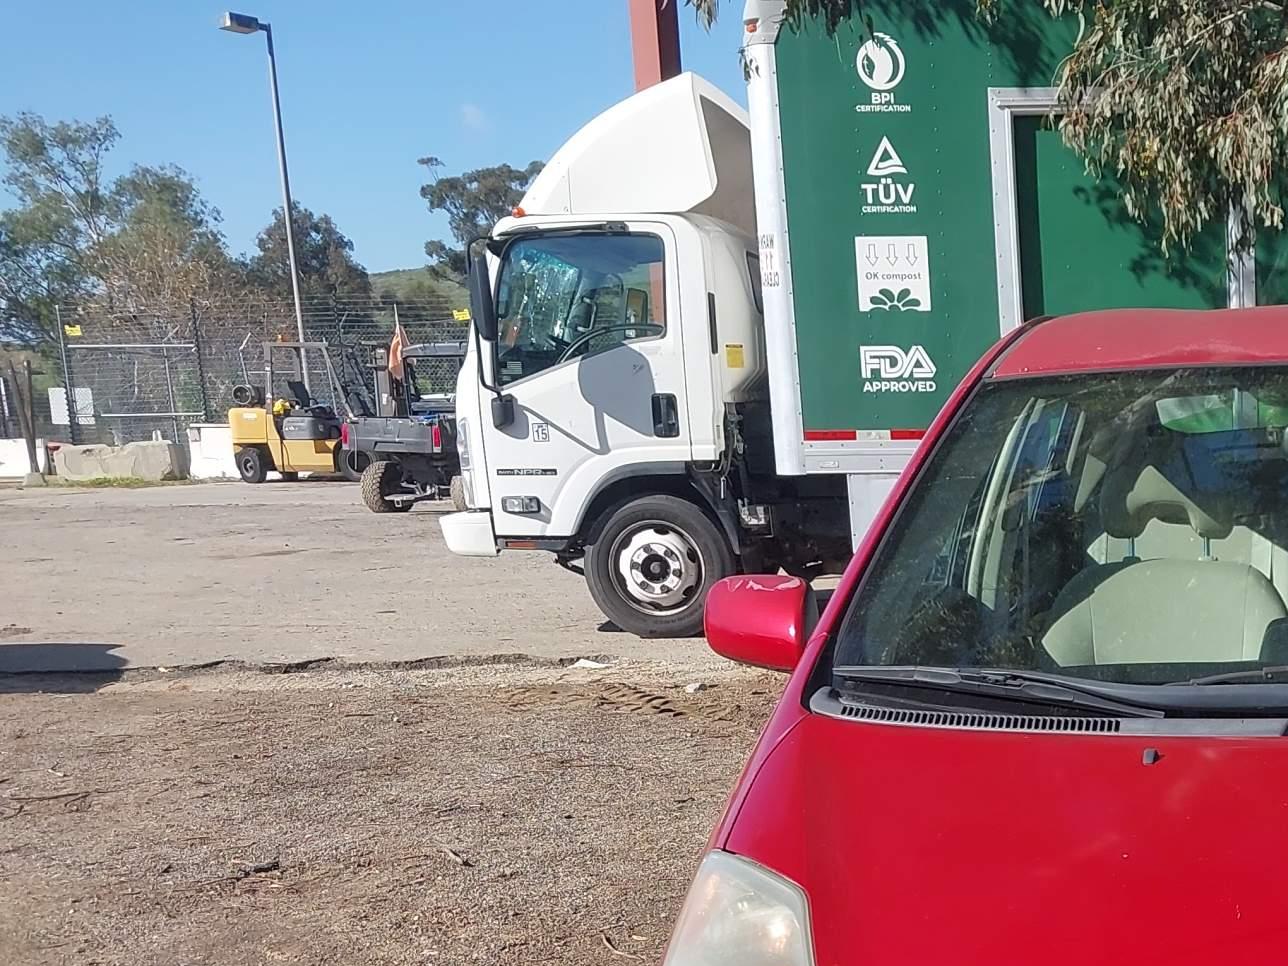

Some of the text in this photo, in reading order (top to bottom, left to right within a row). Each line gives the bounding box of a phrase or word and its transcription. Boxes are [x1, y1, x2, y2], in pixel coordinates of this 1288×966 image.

[871, 92, 895, 104] BPI
[855, 104, 912, 113] CERTIFICATION
[860, 177, 915, 205] TÜV
[861, 205, 917, 214] CERTIFICATION
[865, 271, 922, 283] OK compost
[859, 345, 937, 379] FDA
[862, 381, 937, 393] APPROVED
[535, 428, 548, 441] 15
